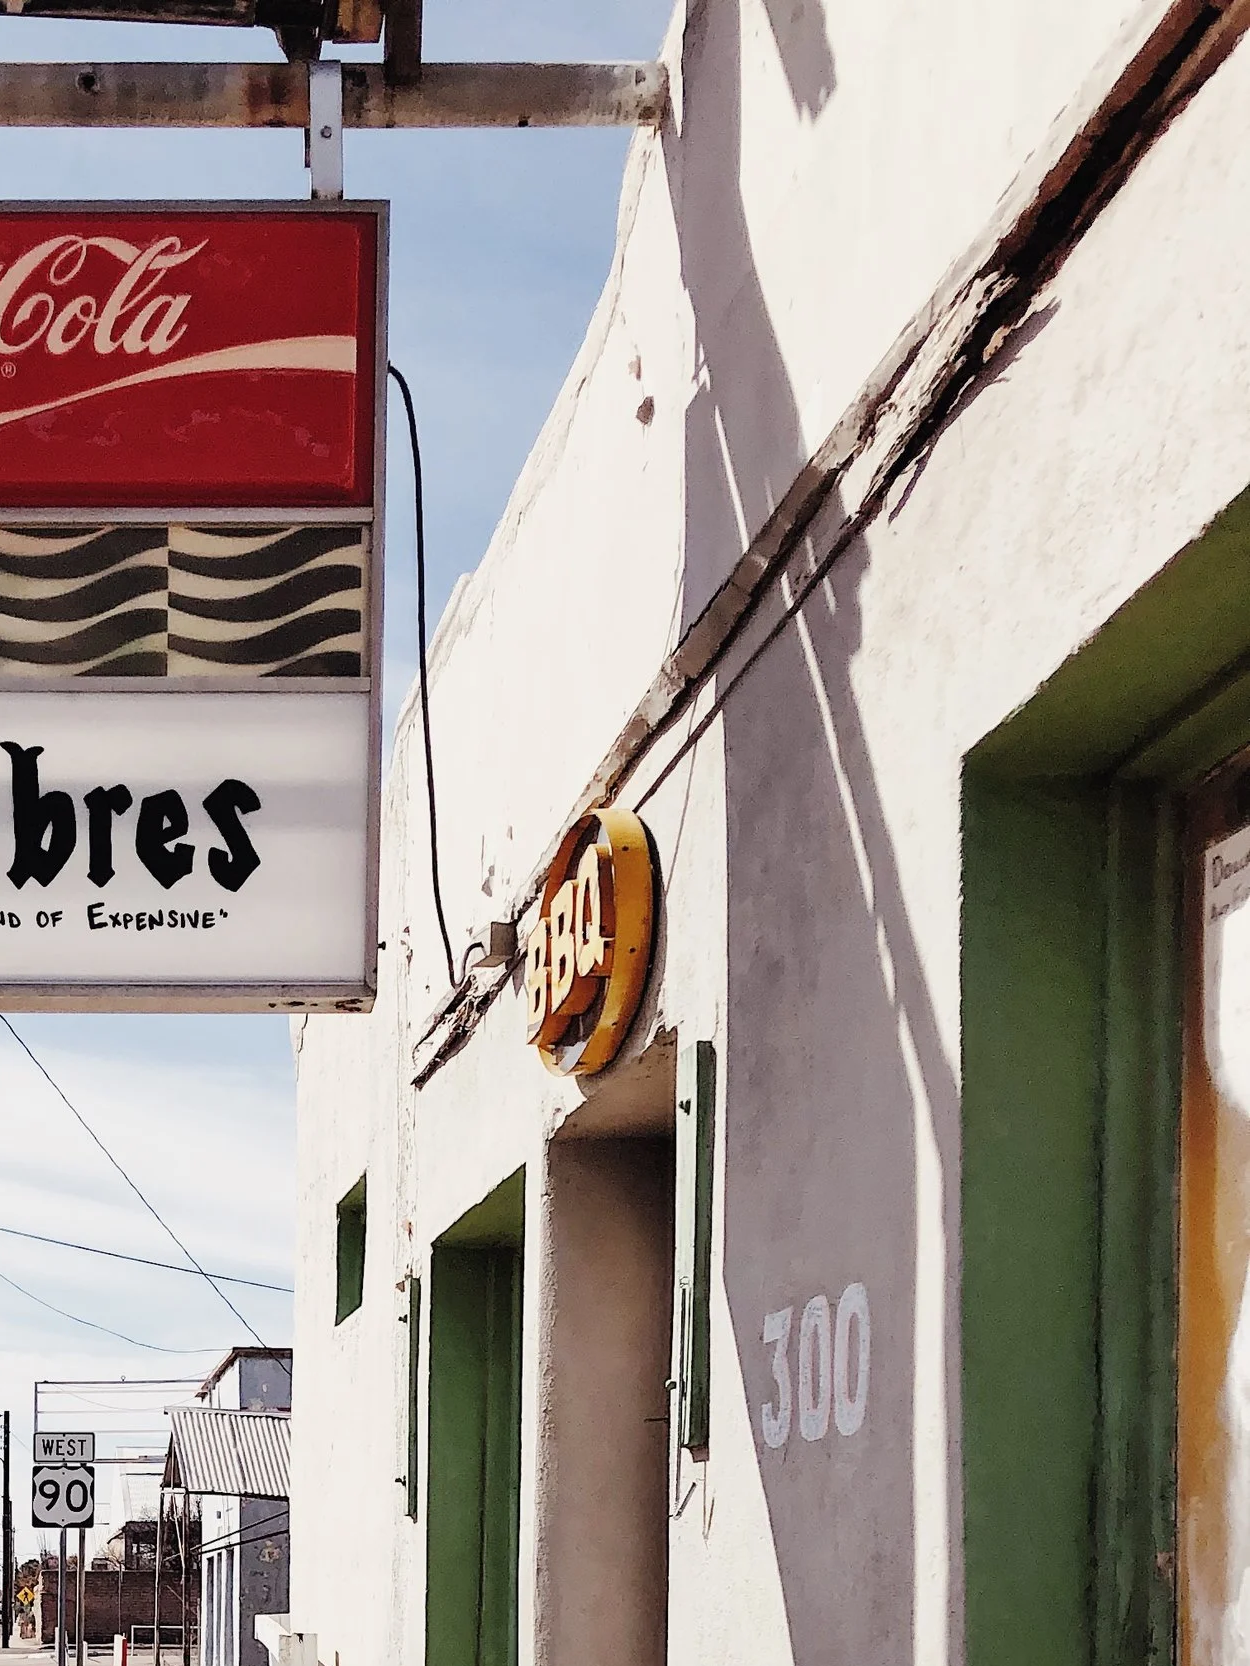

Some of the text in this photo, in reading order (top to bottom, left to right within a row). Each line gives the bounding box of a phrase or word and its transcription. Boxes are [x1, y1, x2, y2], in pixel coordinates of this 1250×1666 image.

[526, 843, 608, 1045] BBQ
[760, 1282, 872, 1450] 300
[38, 1479, 89, 1513] 90
[41, 1438, 87, 1457] WEST
